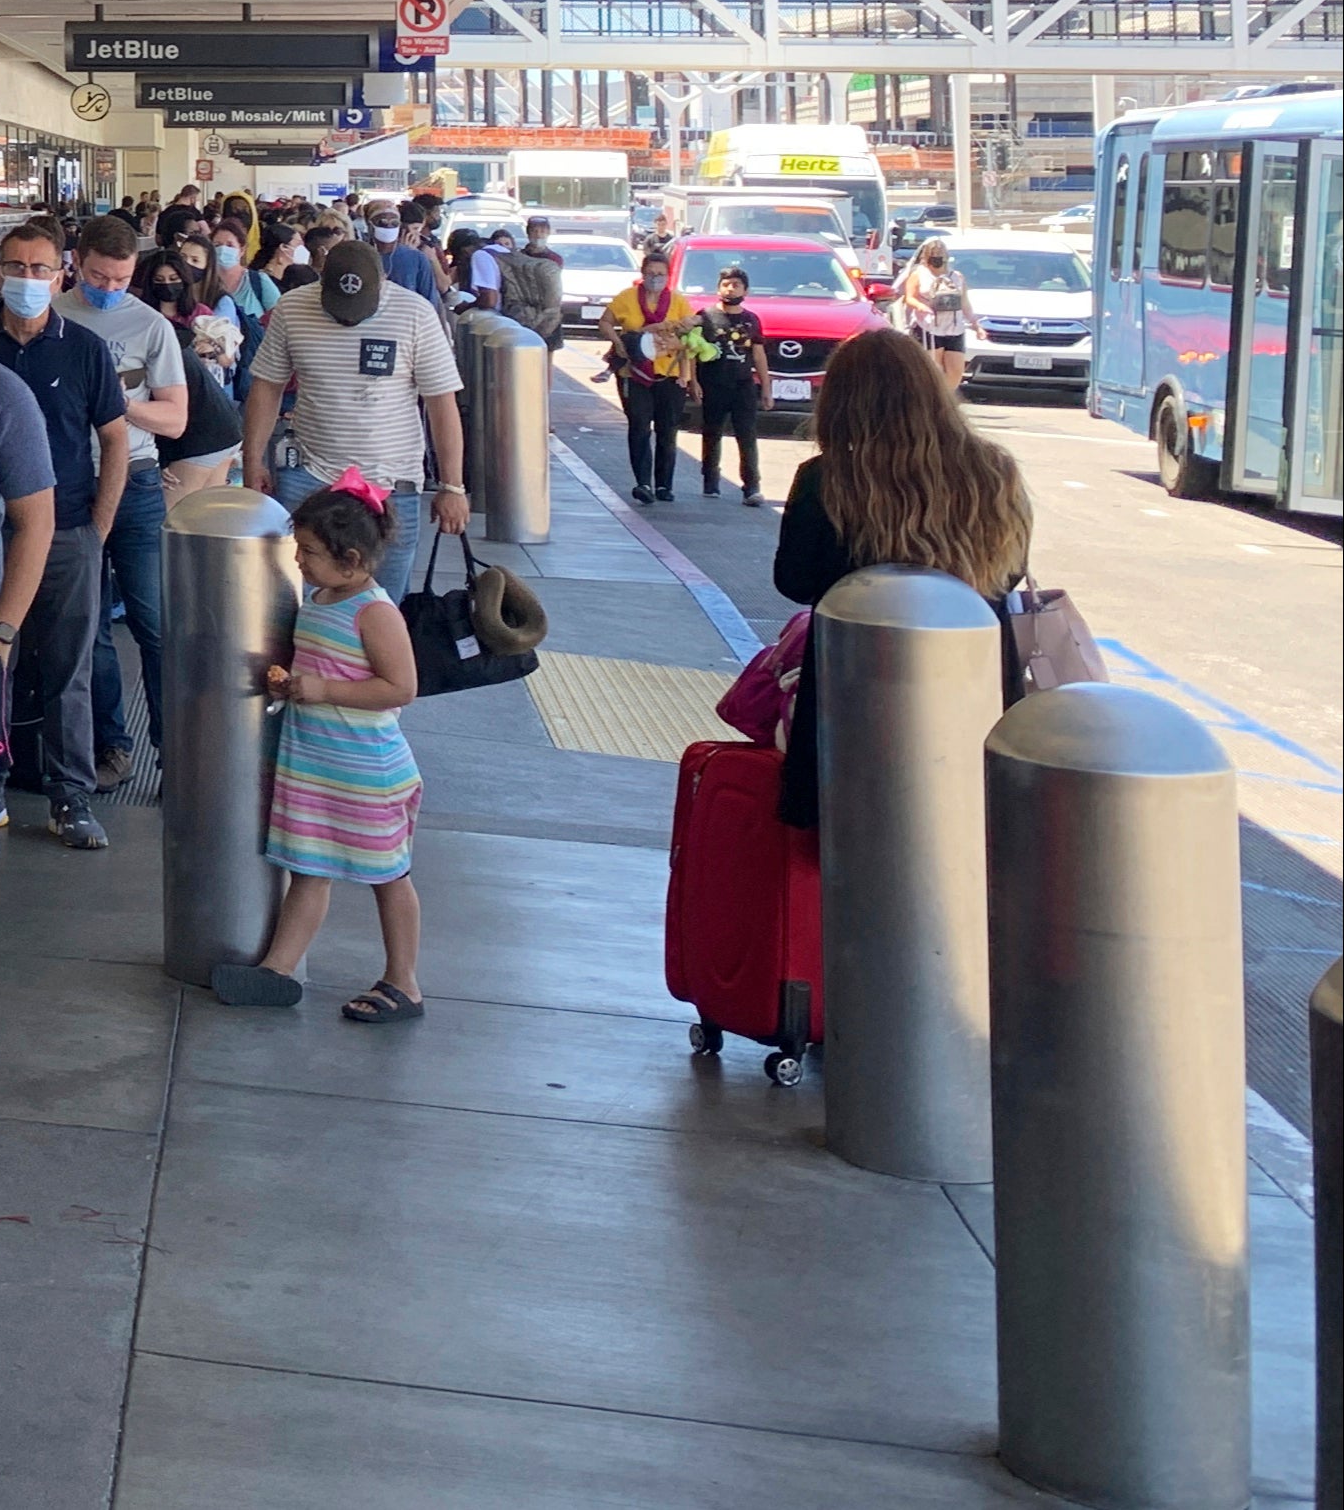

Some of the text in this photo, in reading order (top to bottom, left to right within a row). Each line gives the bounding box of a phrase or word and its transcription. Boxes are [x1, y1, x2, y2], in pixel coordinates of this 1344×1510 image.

[86, 40, 180, 60] JetBlue
[148, 88, 213, 101] JetBlue
[174, 110, 227, 122] JetBlue
[231, 110, 326, 124] Mosaic/Mint
[780, 158, 840, 172] Hertz
